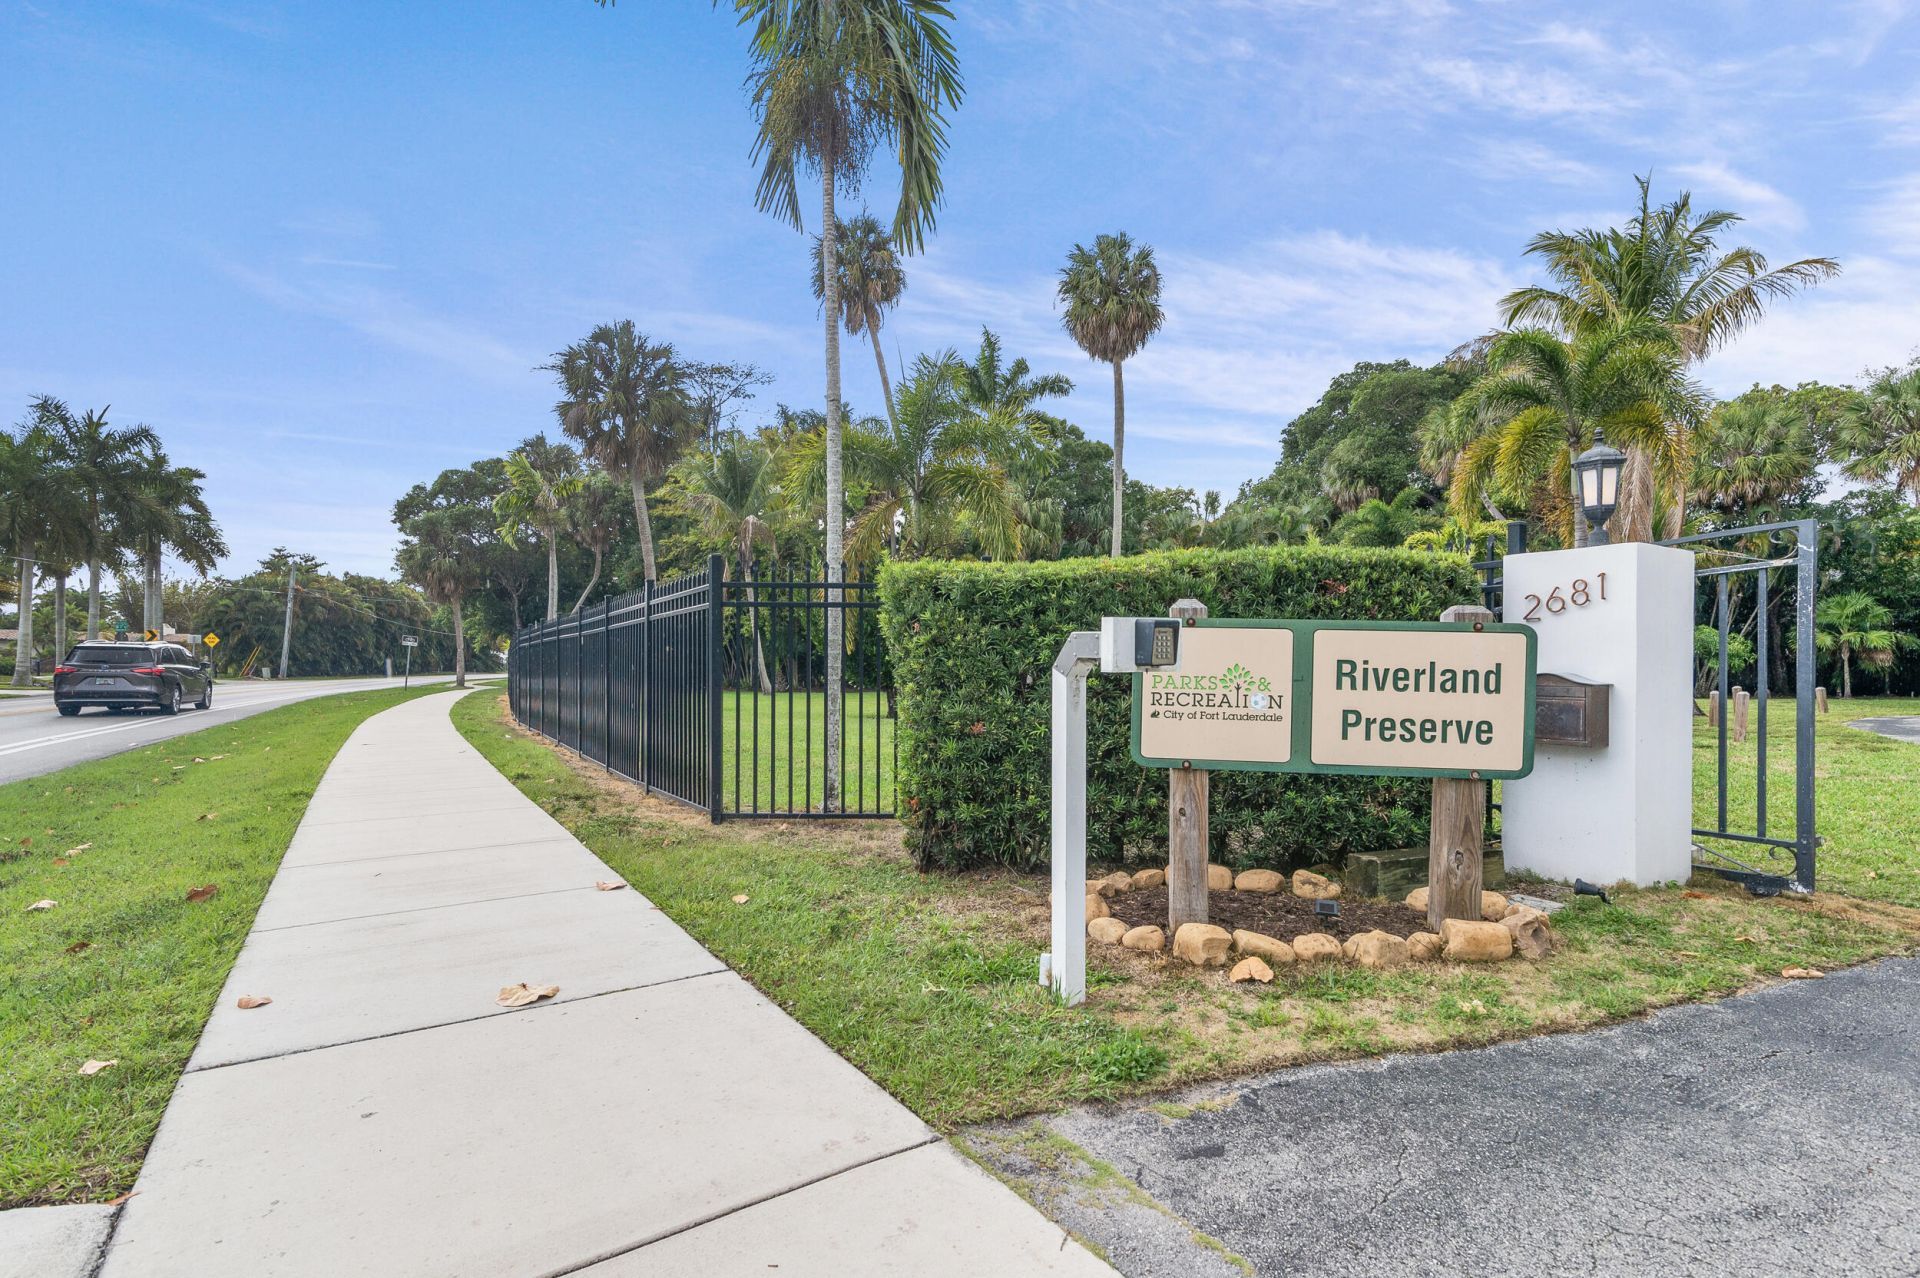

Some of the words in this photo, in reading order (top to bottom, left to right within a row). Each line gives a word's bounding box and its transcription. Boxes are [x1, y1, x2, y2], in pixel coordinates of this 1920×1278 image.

[1522, 572, 1607, 622] 2681
[1151, 674, 1218, 691] PARKS
[1257, 676, 1272, 692] &
[1335, 659, 1502, 694] Riverland
[1163, 710, 1183, 721] City
[1187, 710, 1198, 720] of
[1200, 711, 1219, 721] Fort
[1222, 711, 1283, 722] Lauderdale
[1341, 709, 1493, 745] Preserve
